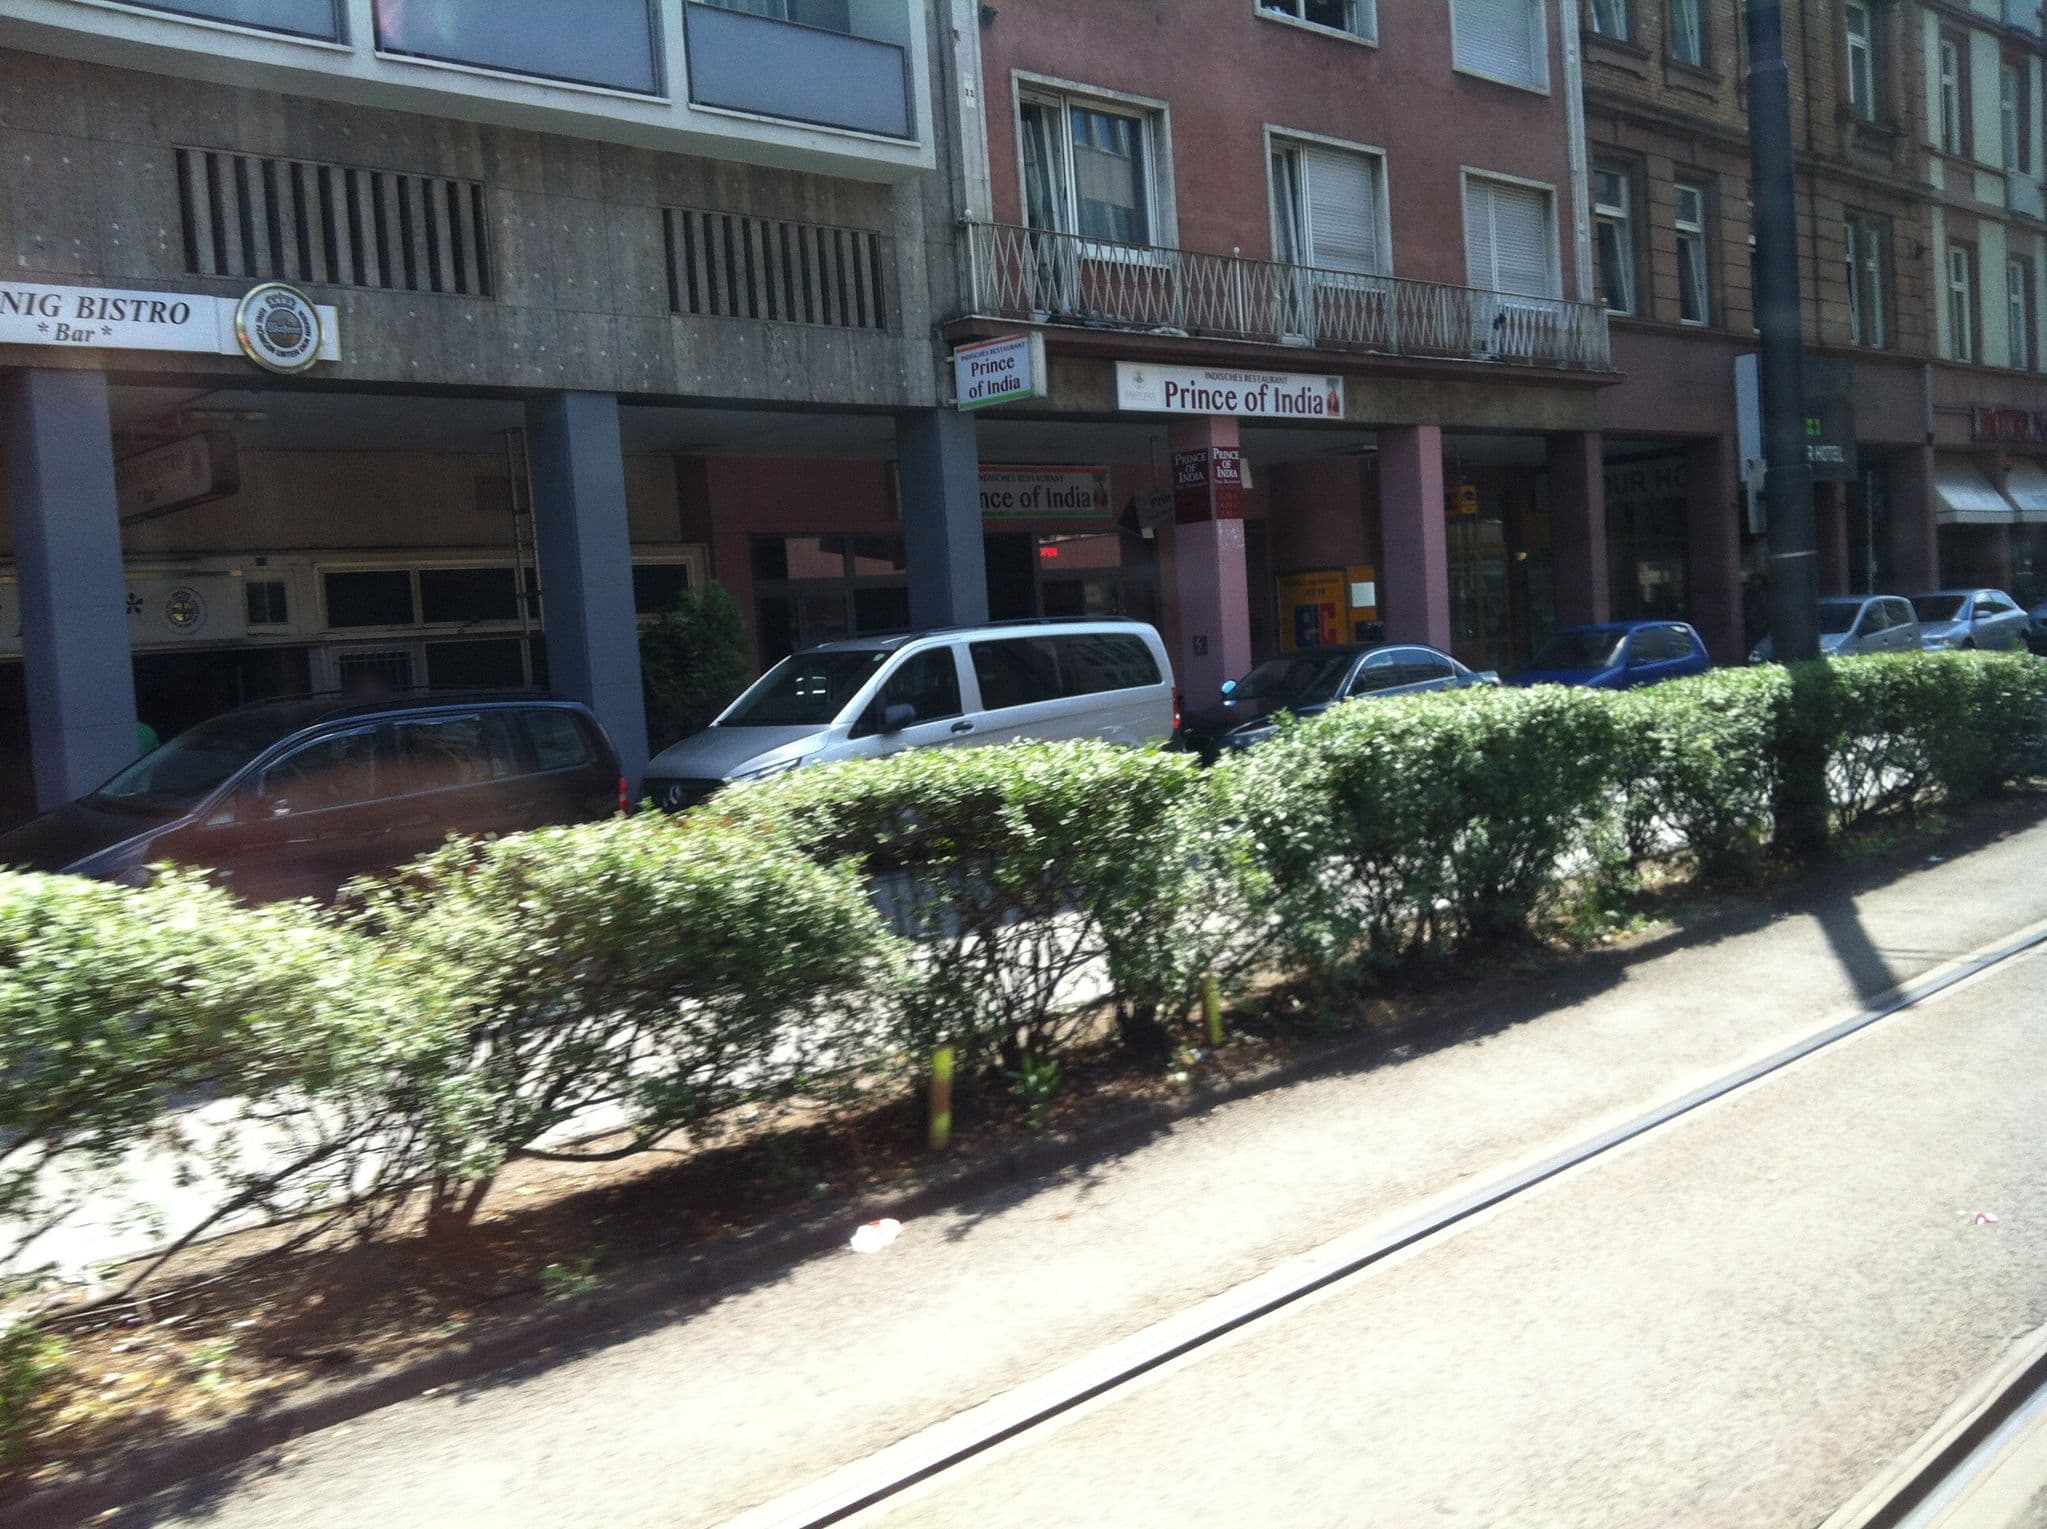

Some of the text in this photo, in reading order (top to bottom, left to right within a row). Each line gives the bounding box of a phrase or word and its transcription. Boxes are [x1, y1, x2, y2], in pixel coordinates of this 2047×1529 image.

[77, 295, 190, 325] BISTRO
[971, 356, 1015, 378] Prince
[1205, 371, 1288, 385] INDISCHES RESTAURANT
[969, 374, 1021, 399] of India
[1164, 380, 1323, 415] Prince of India
[1213, 448, 1240, 460] PRINCE
[1221, 460, 1232, 469] OF
[1216, 466, 1238, 478] INDIA
[1019, 485, 1041, 508] of
[1046, 486, 1091, 508] India
